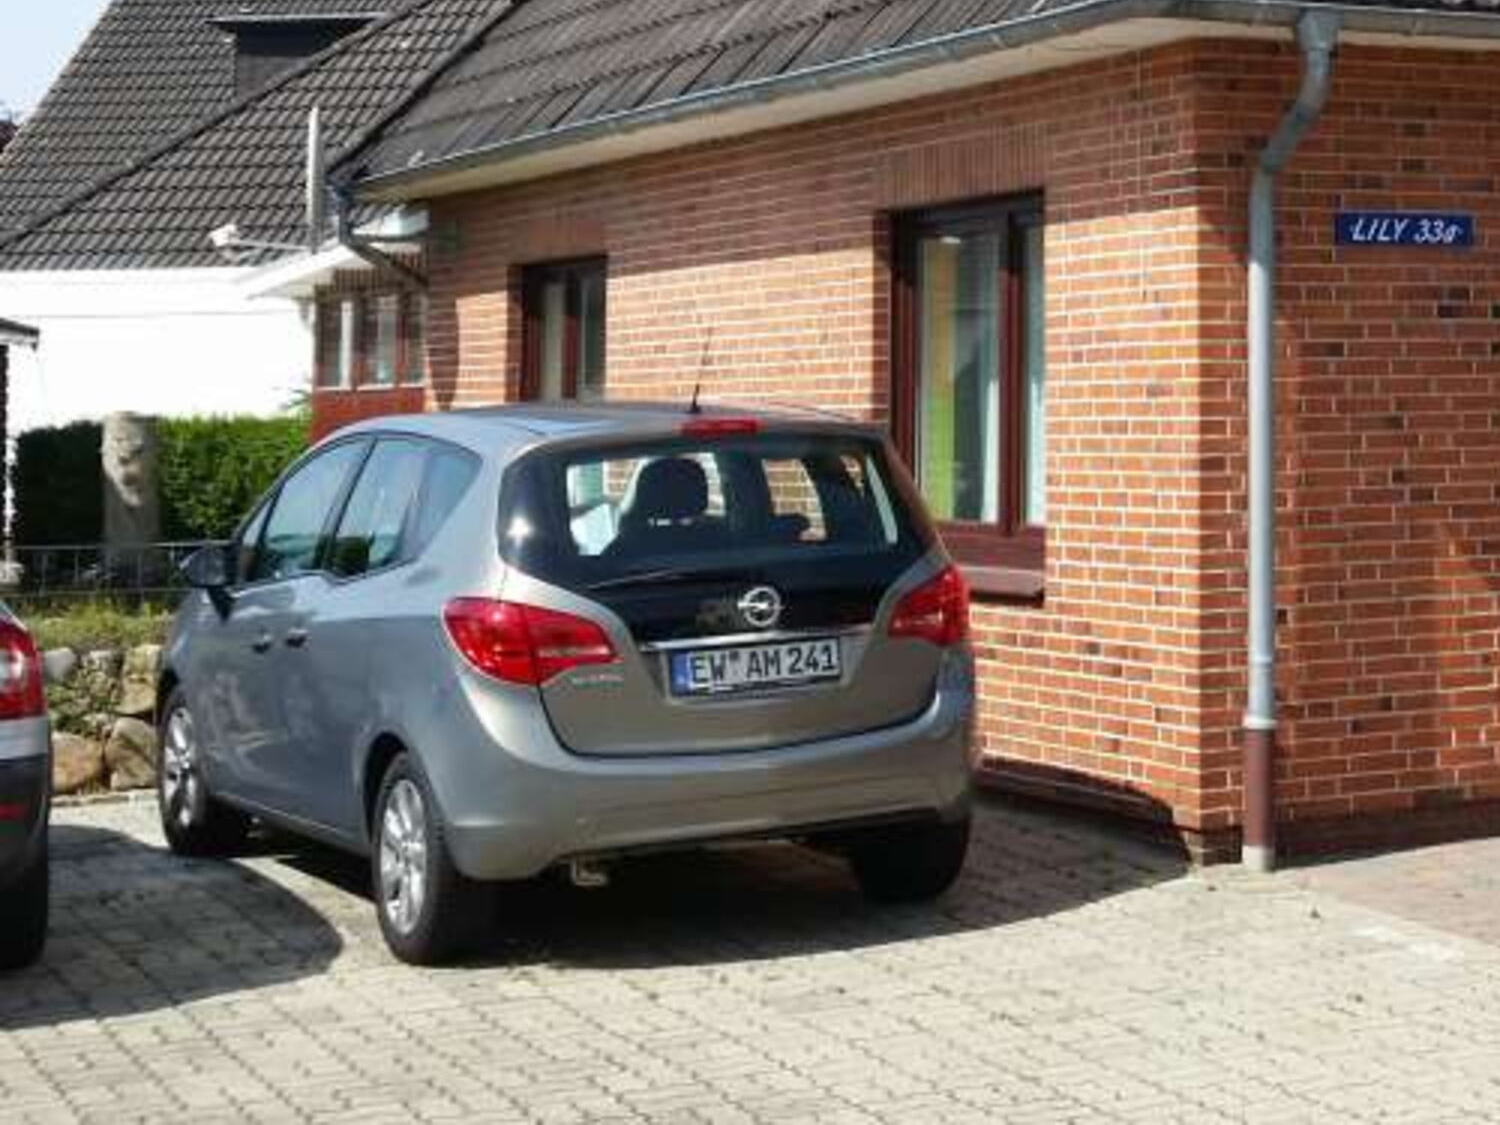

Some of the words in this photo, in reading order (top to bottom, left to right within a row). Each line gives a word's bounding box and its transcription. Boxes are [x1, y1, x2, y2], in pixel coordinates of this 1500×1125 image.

[1352, 218, 1408, 241] LILY
[693, 653, 727, 683] EW
[746, 649, 781, 678] AM
[787, 645, 836, 675] 241
